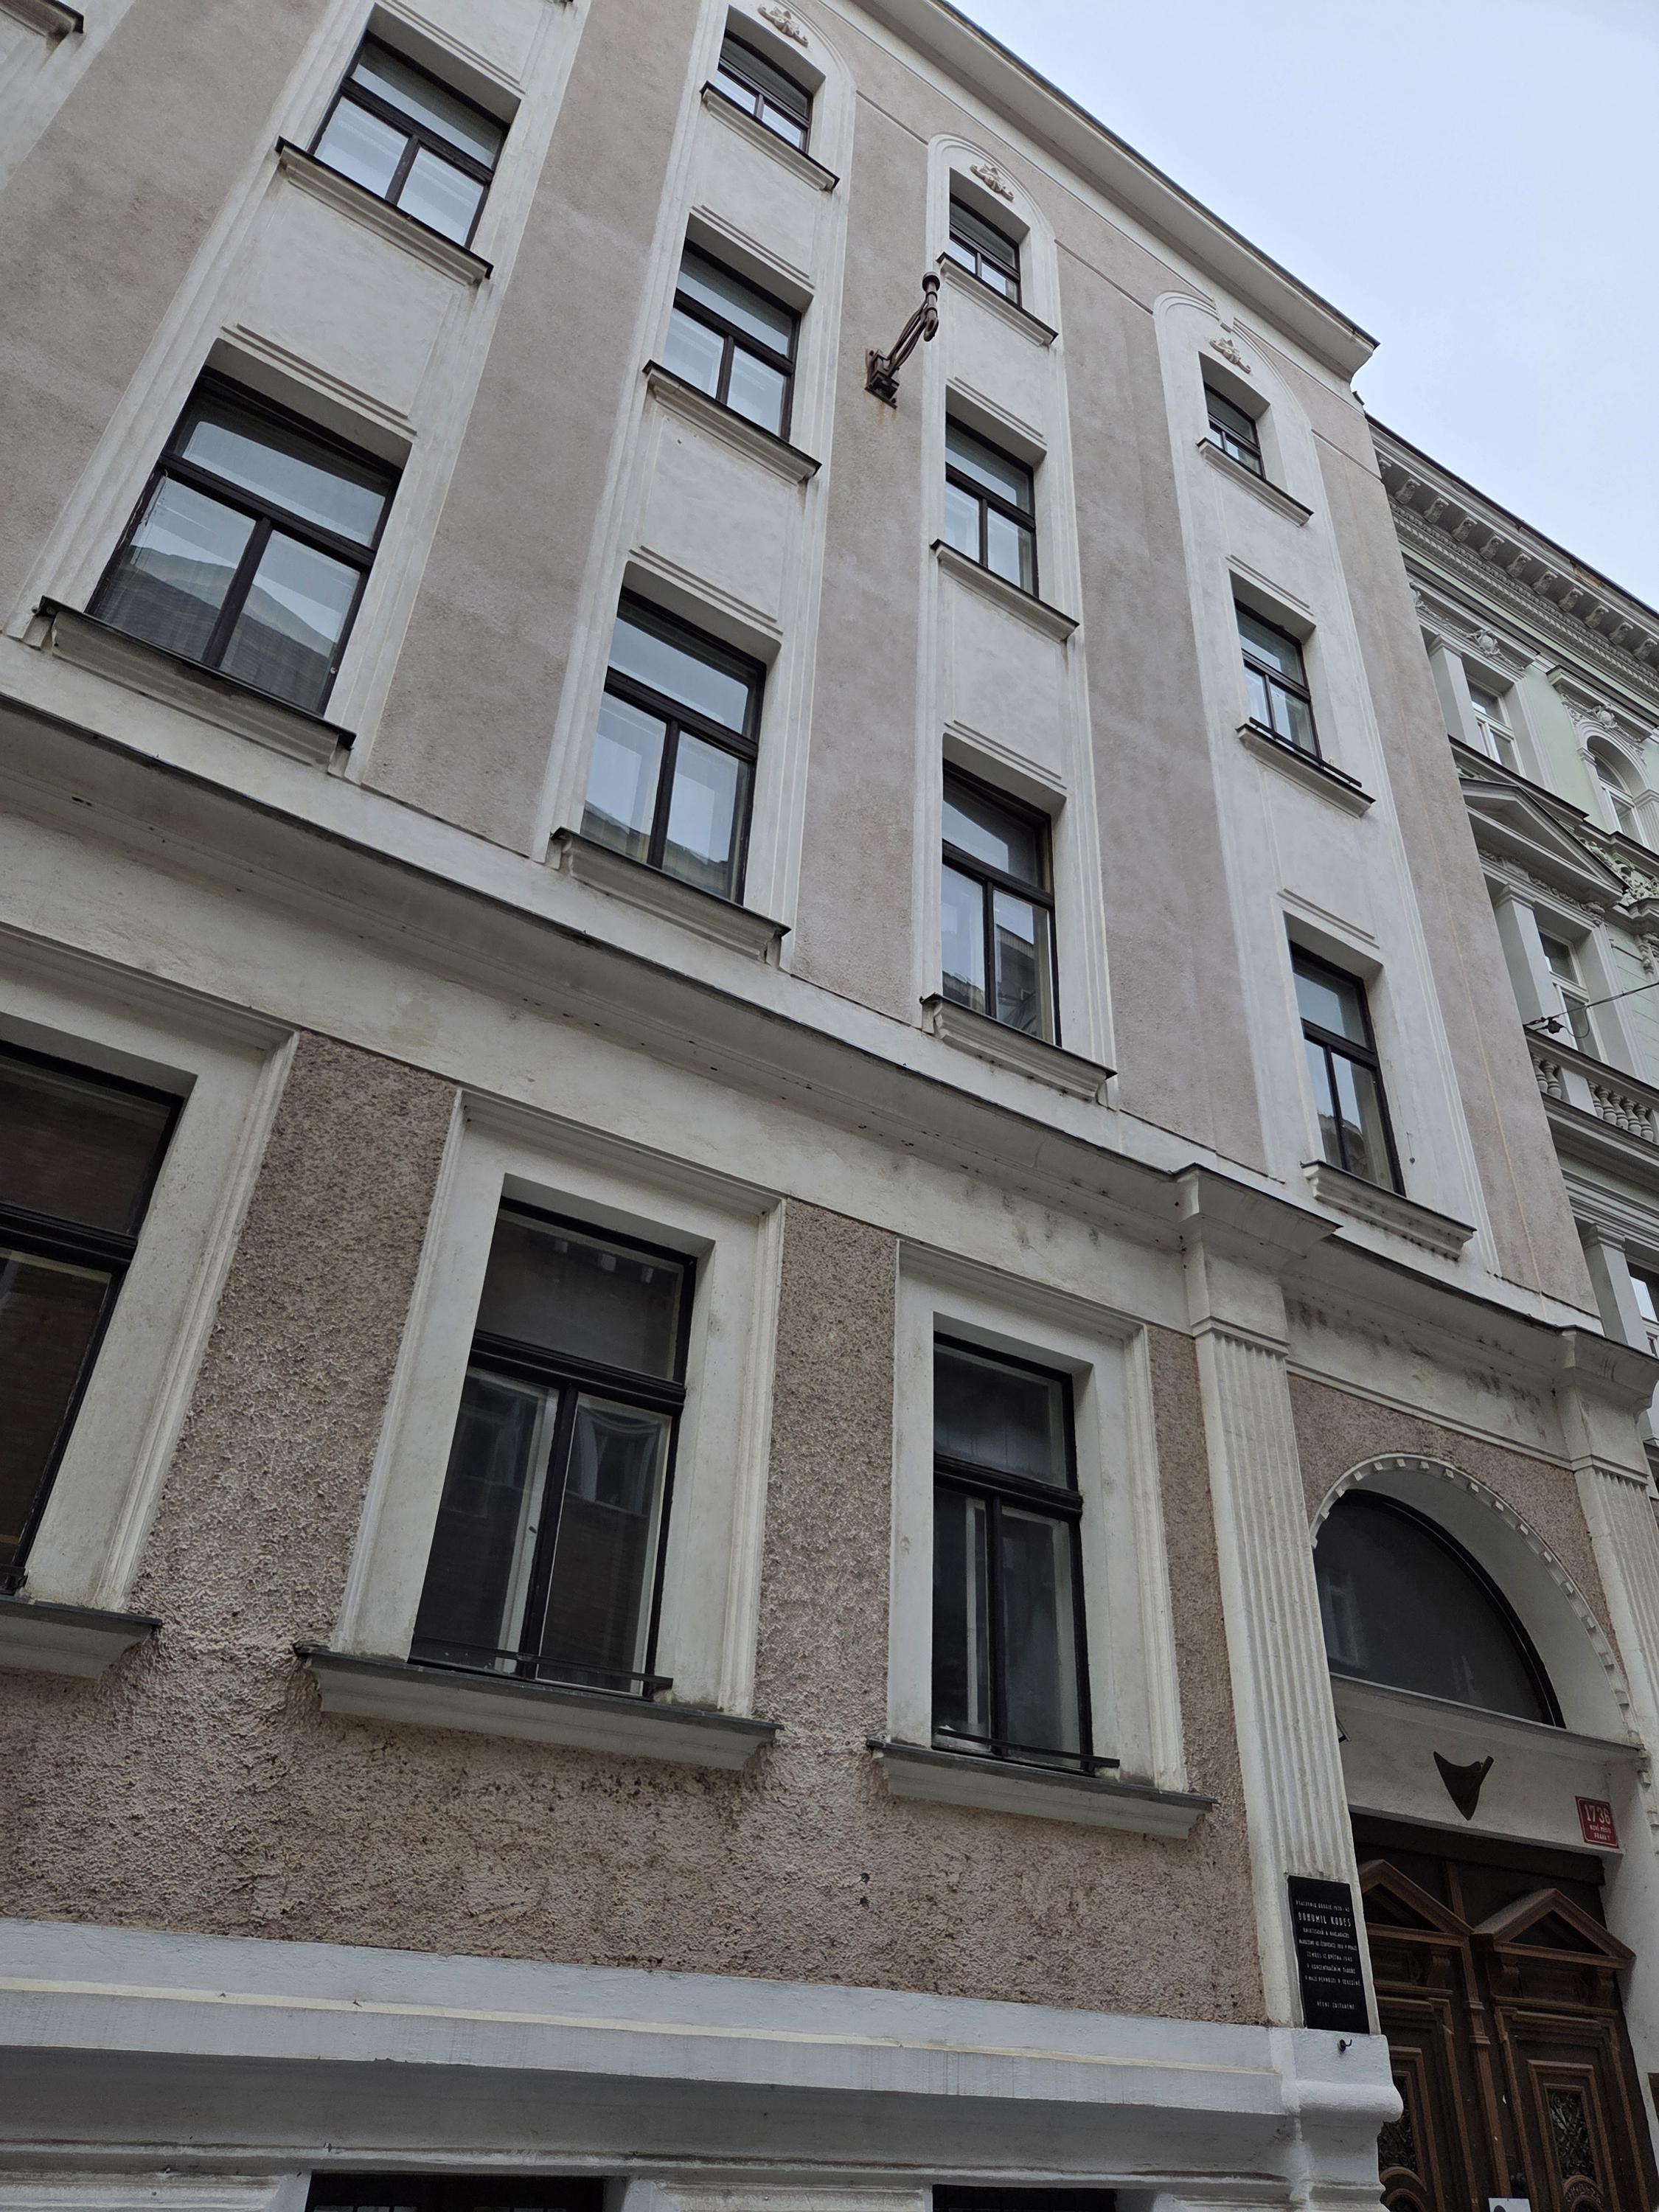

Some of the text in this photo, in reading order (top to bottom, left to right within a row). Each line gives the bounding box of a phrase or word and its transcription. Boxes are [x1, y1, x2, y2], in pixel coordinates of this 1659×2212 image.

[1585, 1804, 1611, 1825] 1736
[1298, 1912, 1351, 1927] BOHUMIL KOBES
